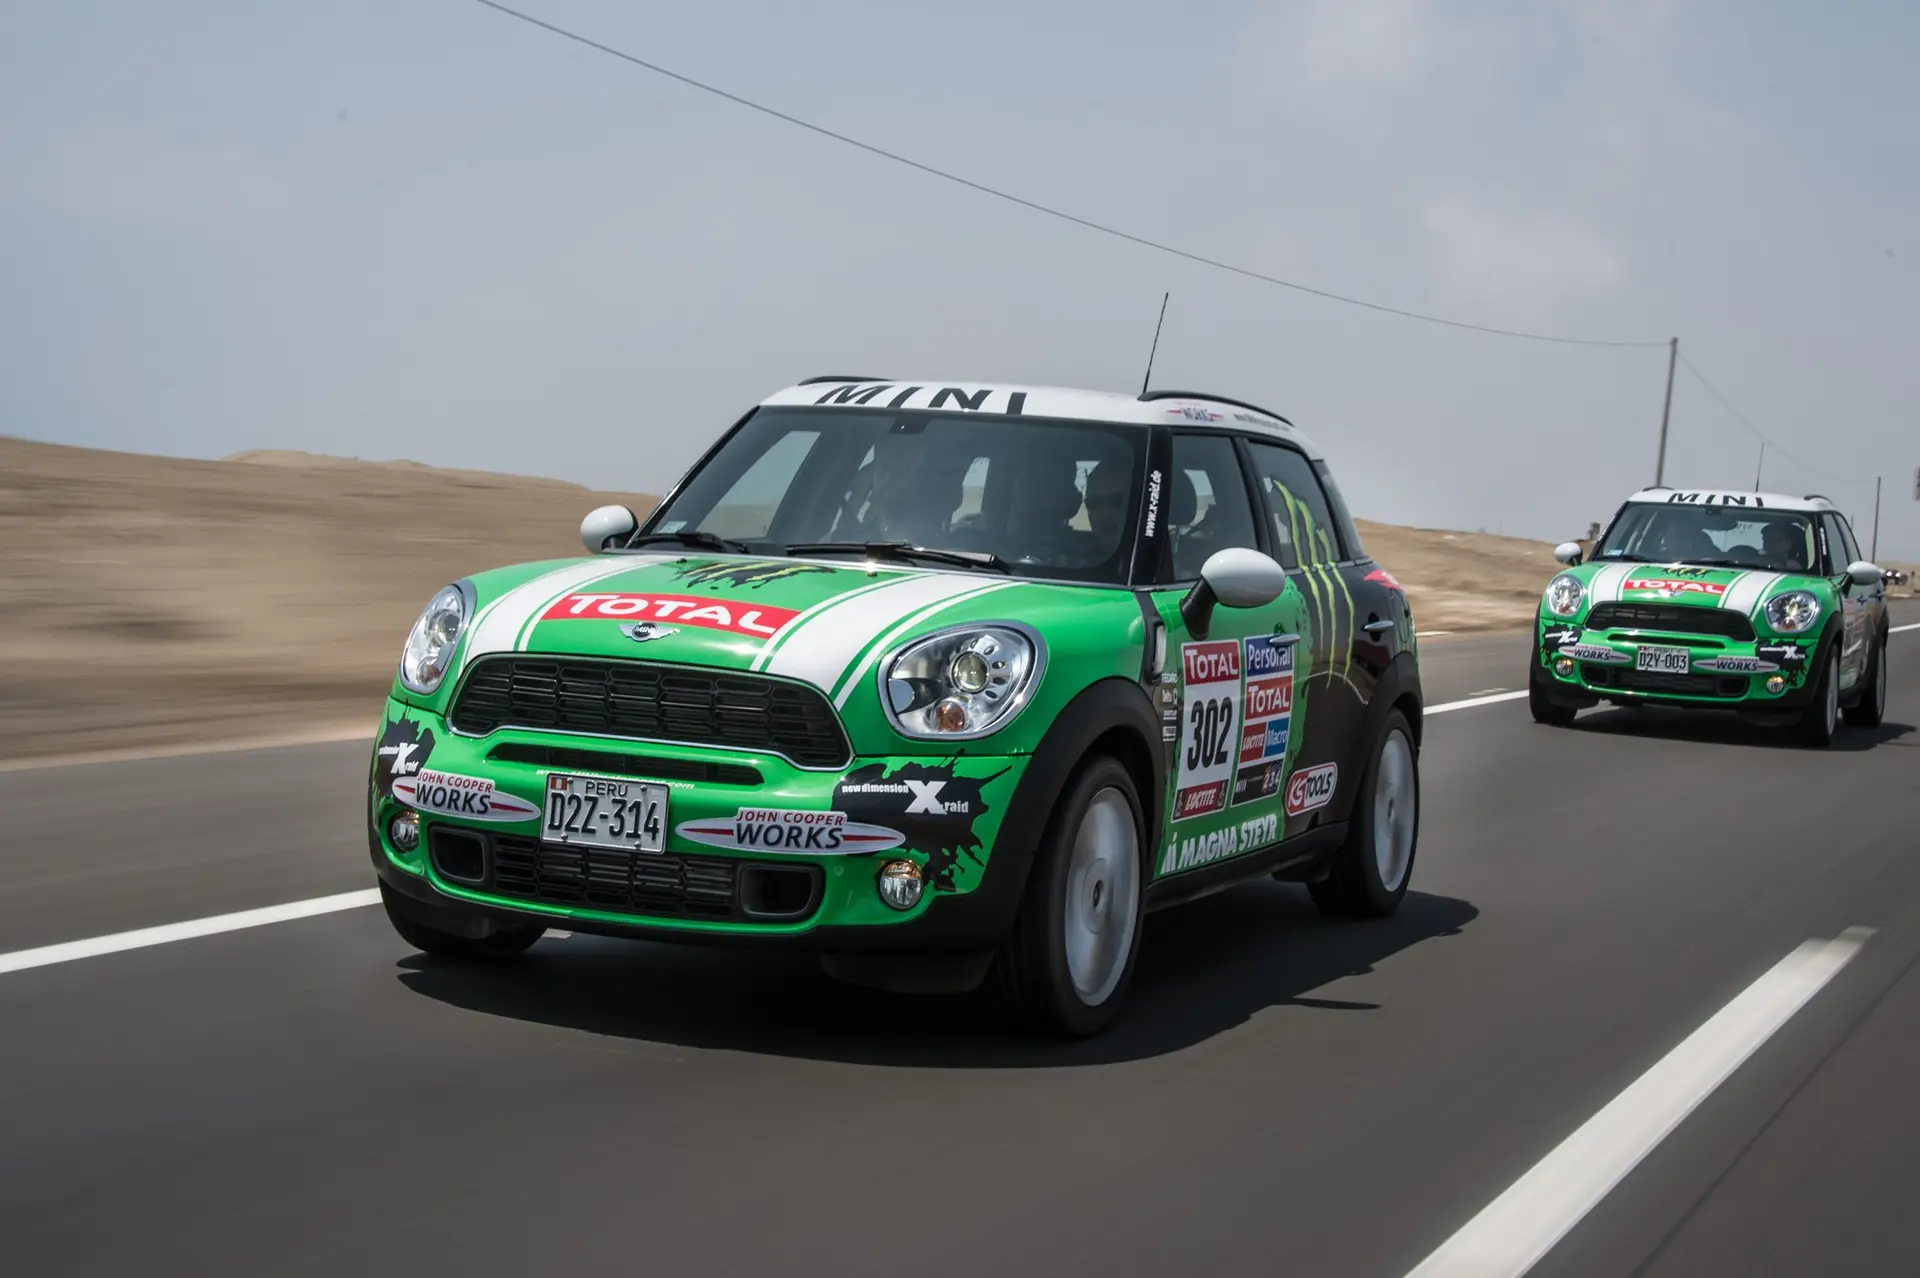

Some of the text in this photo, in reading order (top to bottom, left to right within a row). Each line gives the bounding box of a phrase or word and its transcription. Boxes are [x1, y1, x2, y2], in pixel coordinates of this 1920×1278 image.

[814, 385, 1028, 415] MINI
[1668, 493, 1764, 508] MINI
[1628, 579, 1723, 593] TOTAL
[569, 595, 777, 633] TOTAL
[1185, 649, 1239, 679] TOTAL
[1575, 649, 1610, 660] WORKS
[1639, 652, 1687, 668] D2Y-003
[1717, 661, 1758, 671] WORKS
[1248, 685, 1290, 714] TOTAL
[1187, 697, 1233, 771] 302
[418, 772, 493, 793] JOHN COOPER
[585, 781, 629, 797] PERU
[416, 783, 491, 814] WORKS
[1185, 788, 1217, 811] LOCTITE
[548, 792, 660, 841] D2Z-314
[736, 811, 844, 826] JOHN COOPER
[736, 823, 843, 849] WORKS
[1177, 825, 1237, 869] MAGNA
[1238, 813, 1277, 851] STEYR
